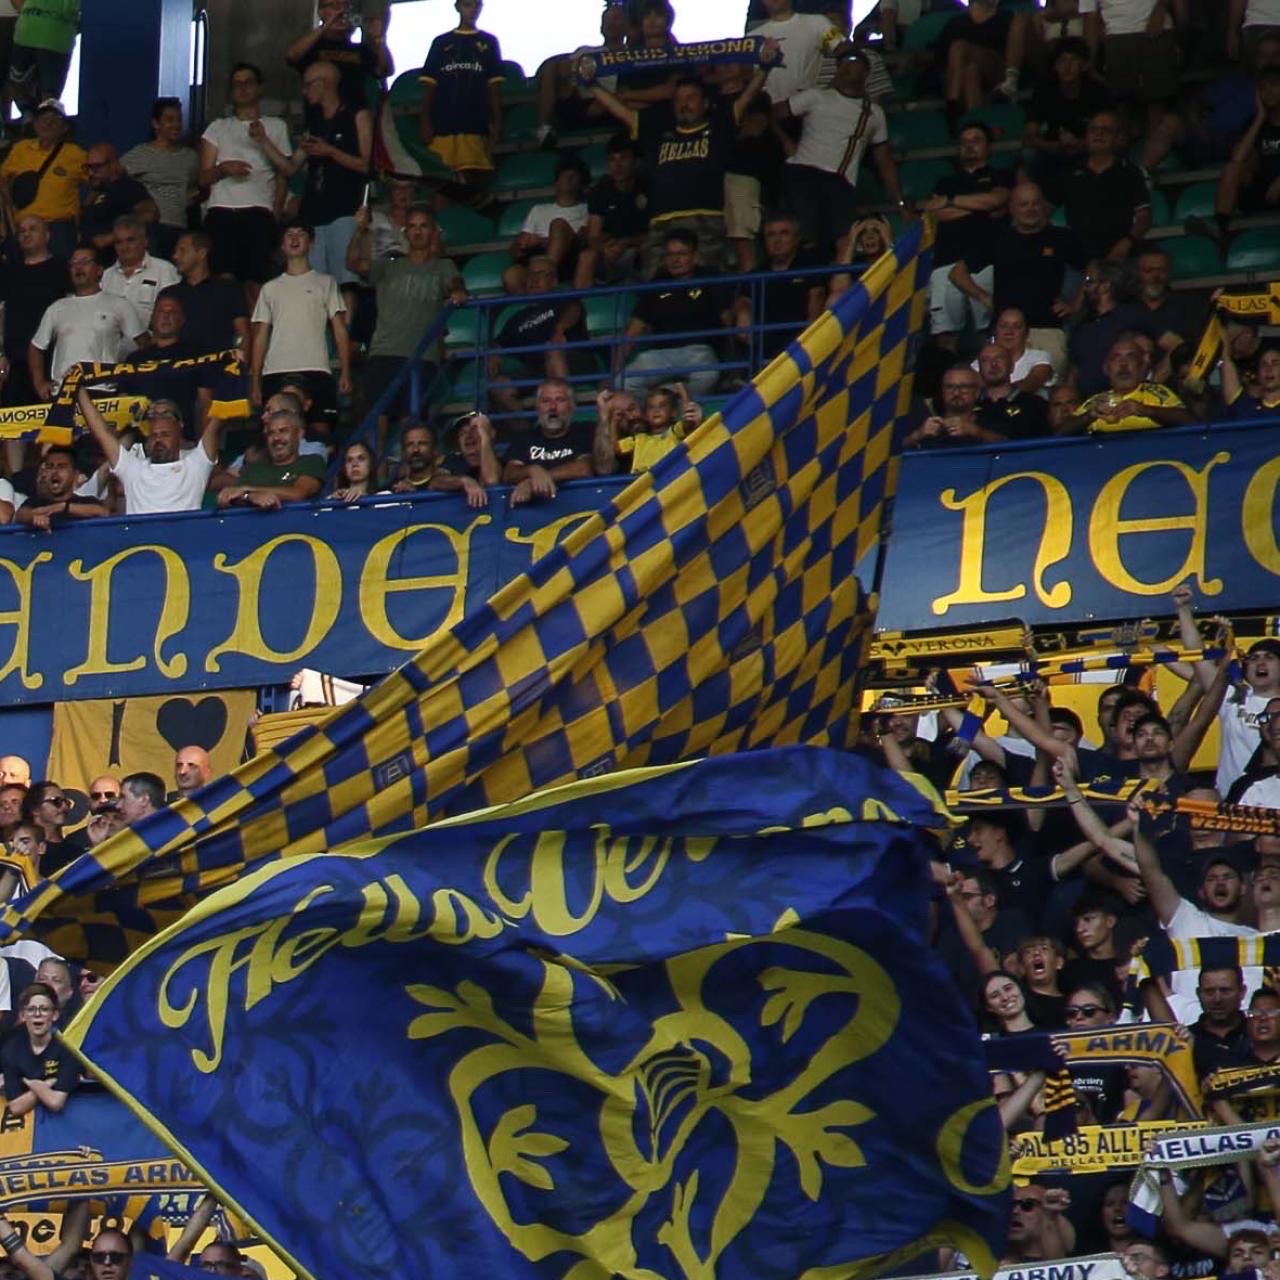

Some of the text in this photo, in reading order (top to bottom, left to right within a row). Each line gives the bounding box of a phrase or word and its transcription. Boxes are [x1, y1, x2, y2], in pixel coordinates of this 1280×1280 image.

[658, 140, 711, 165] HELLAS
[912, 636, 996, 654] VERONA
[1087, 1032, 1186, 1055] ARMY
[1148, 1134, 1254, 1160] HELLAS
[124, 1160, 205, 1186] ARM
